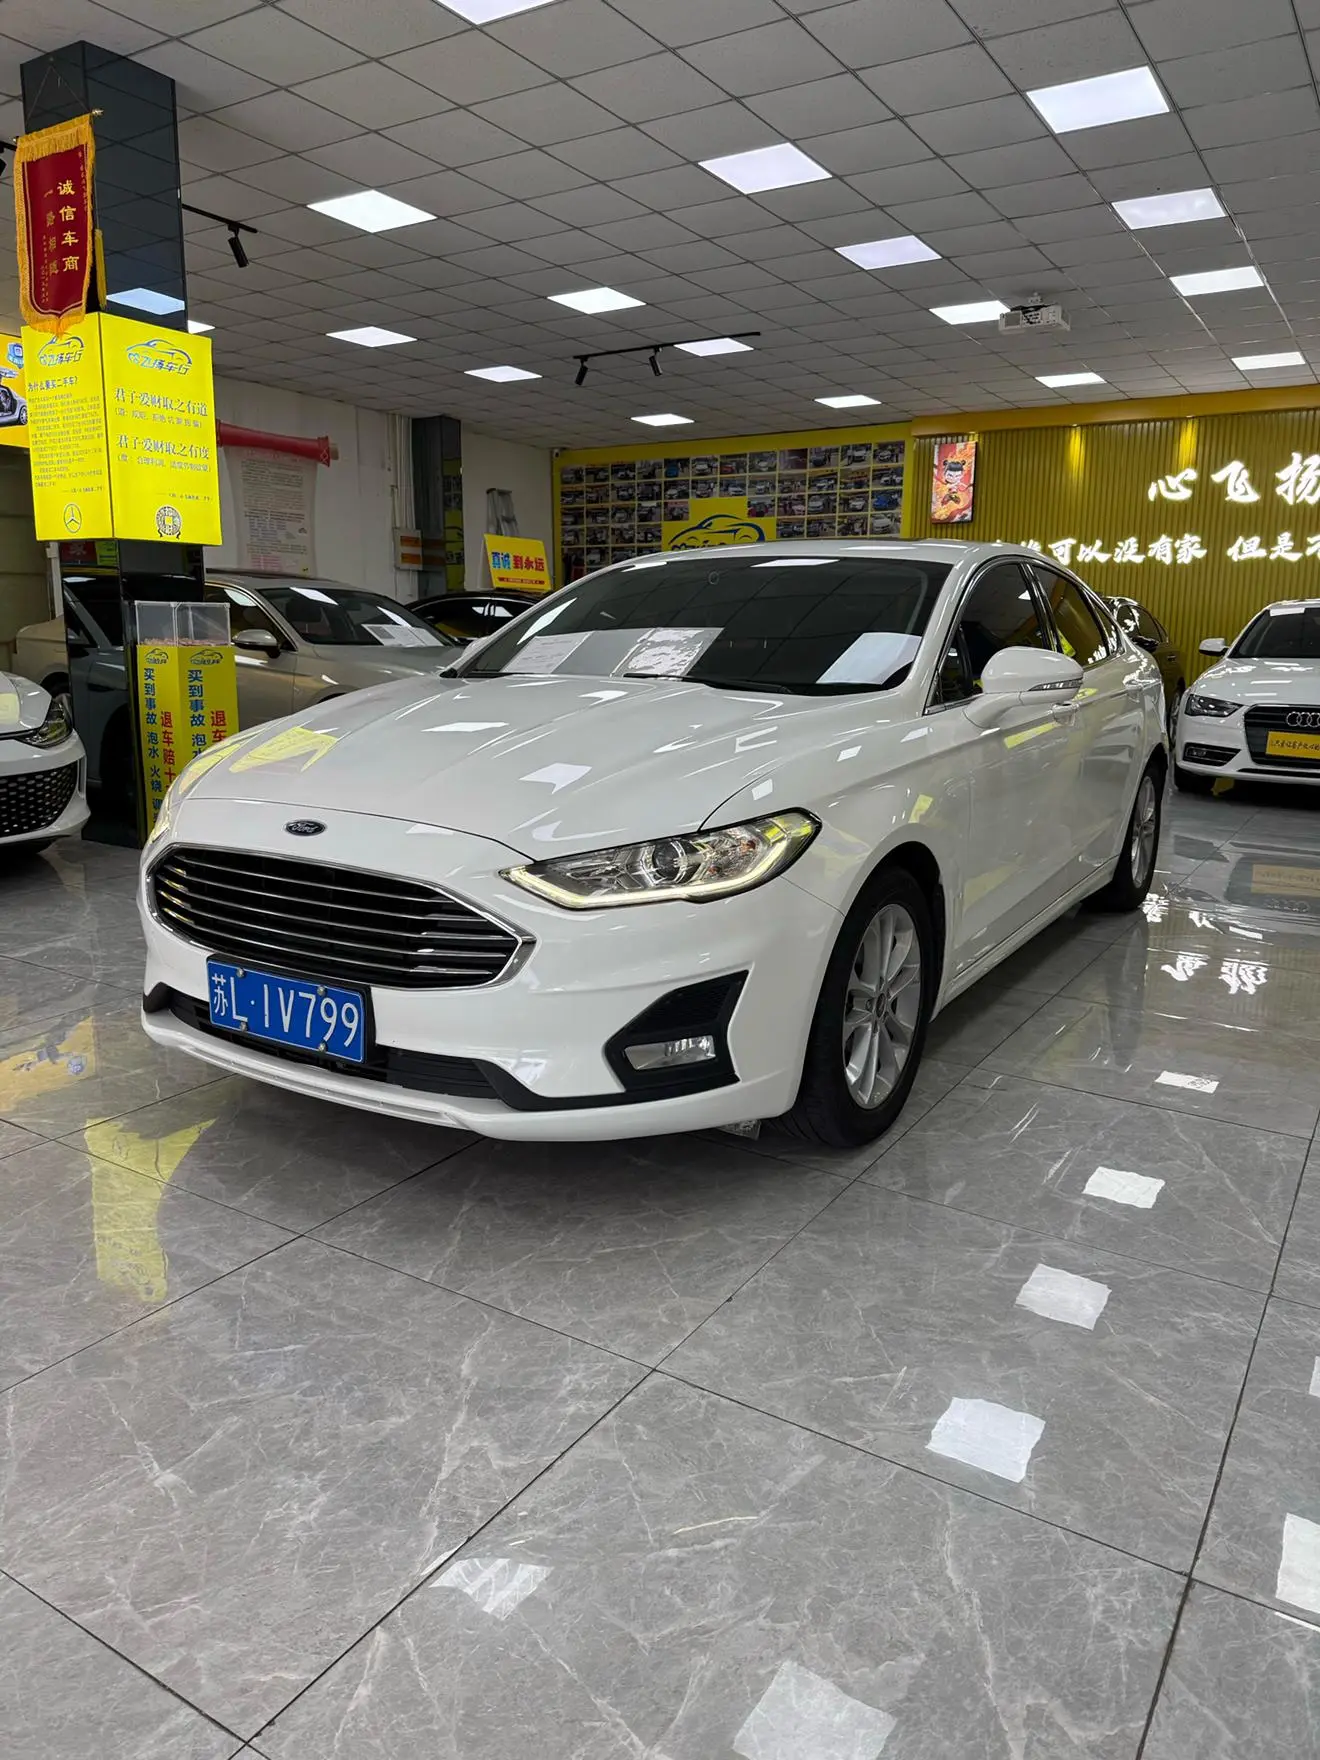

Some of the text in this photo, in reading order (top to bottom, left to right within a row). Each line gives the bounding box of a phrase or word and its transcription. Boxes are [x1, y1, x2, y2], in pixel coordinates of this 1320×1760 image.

[57, 180, 80, 272] 诚信车商
[115, 387, 209, 417] 君子爱财取之有道
[117, 434, 210, 460] 君子爱财取之有度
[1148, 452, 1320, 505] 心飞扬
[1020, 533, 1208, 566] 可以没有家
[143, 668, 158, 726] 买到事故
[187, 669, 206, 728] 买到事故
[147, 732, 160, 759] 泡水
[160, 711, 176, 789] 退车赔十
